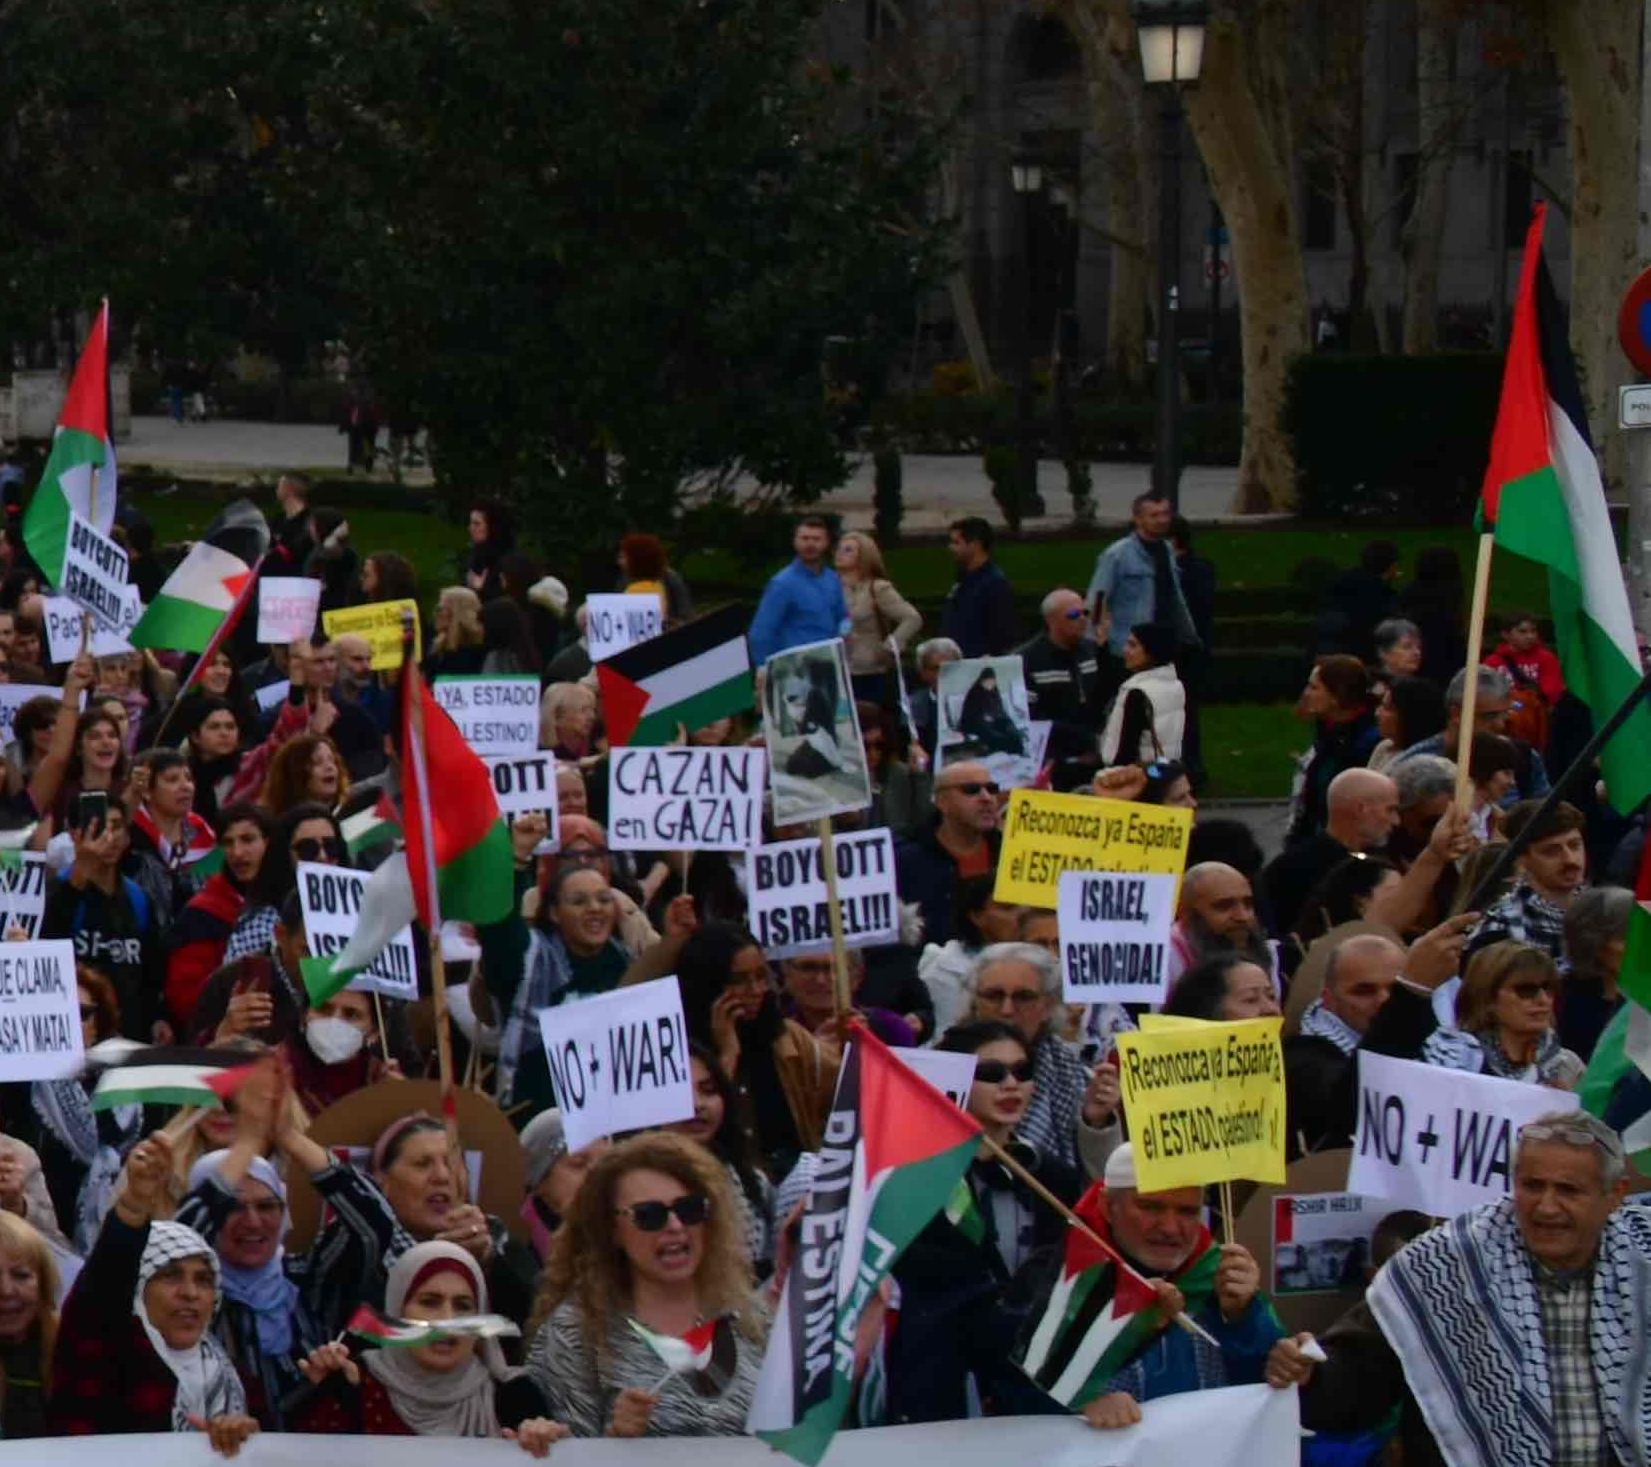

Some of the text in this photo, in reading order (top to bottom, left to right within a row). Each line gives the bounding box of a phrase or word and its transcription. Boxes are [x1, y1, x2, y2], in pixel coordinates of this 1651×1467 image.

[472, 685, 536, 706] ESTADO
[614, 750, 748, 795] CAZAN
[616, 798, 752, 845] en GAZA!
[1011, 798, 1182, 854] ¡Reconozca ya España
[1010, 850, 1024, 881] el
[1079, 880, 1150, 924] ISRAEL,
[17, 958, 65, 999] CLAMA,
[1067, 942, 1163, 986] GENOCIDA!
[31, 1014, 72, 1052] MATA!
[547, 1013, 687, 1113] NO + WAR!
[1126, 1047, 1208, 1102] ¡Reconozca
[1226, 1041, 1273, 1078] España
[1144, 1124, 1156, 1159] el
[1159, 1108, 1216, 1157] ESTADO
[1359, 1088, 1405, 1166] NO
[1416, 1115, 1439, 1165] +
[798, 1110, 858, 1390] PALESTINA
